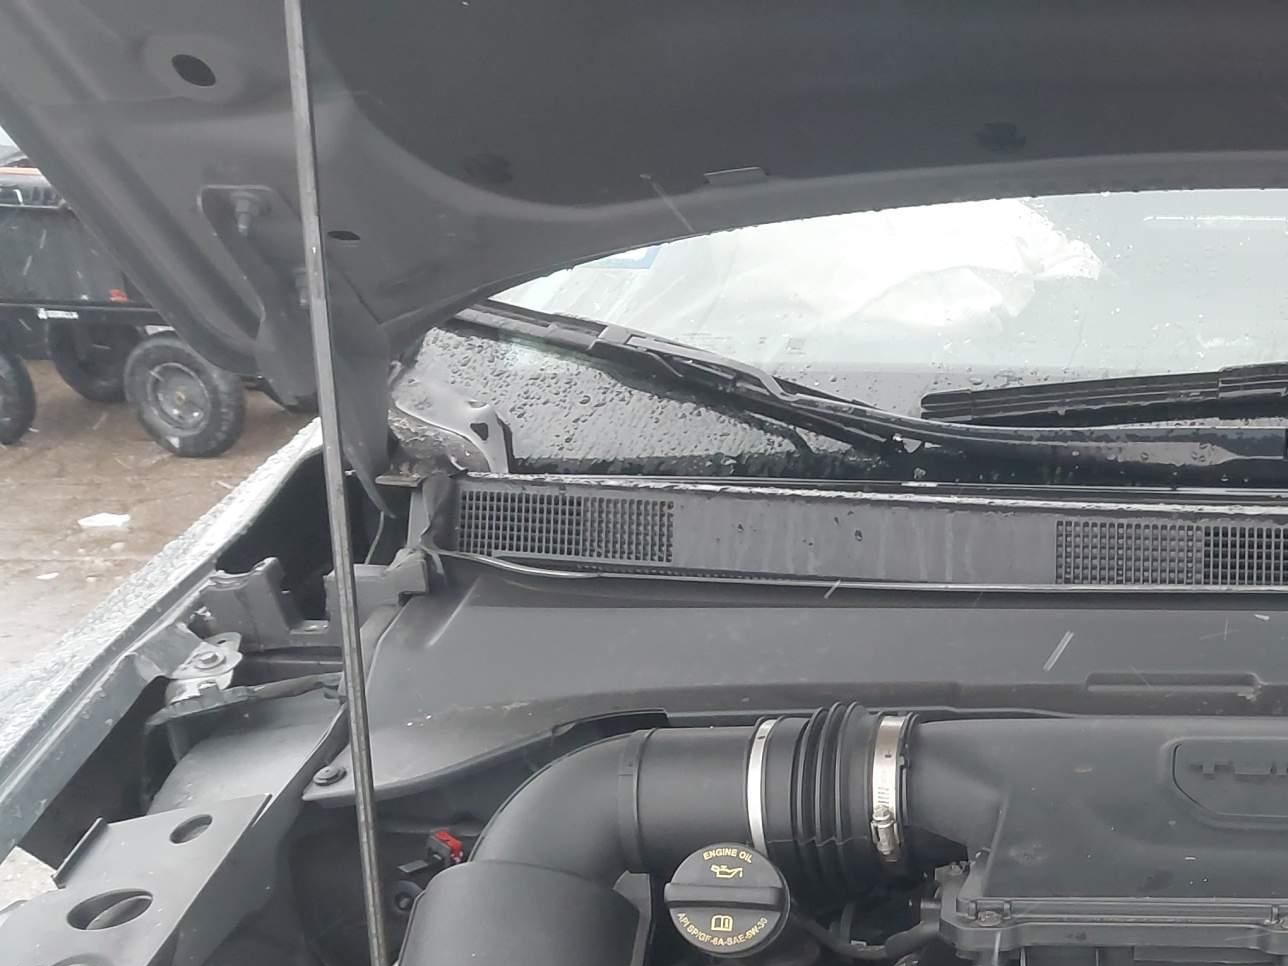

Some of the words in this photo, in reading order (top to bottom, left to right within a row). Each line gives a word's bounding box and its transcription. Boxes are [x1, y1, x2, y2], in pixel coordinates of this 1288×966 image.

[703, 848, 737, 860] ENGINE
[739, 851, 753, 863] OIL
[677, 912, 689, 928] API
